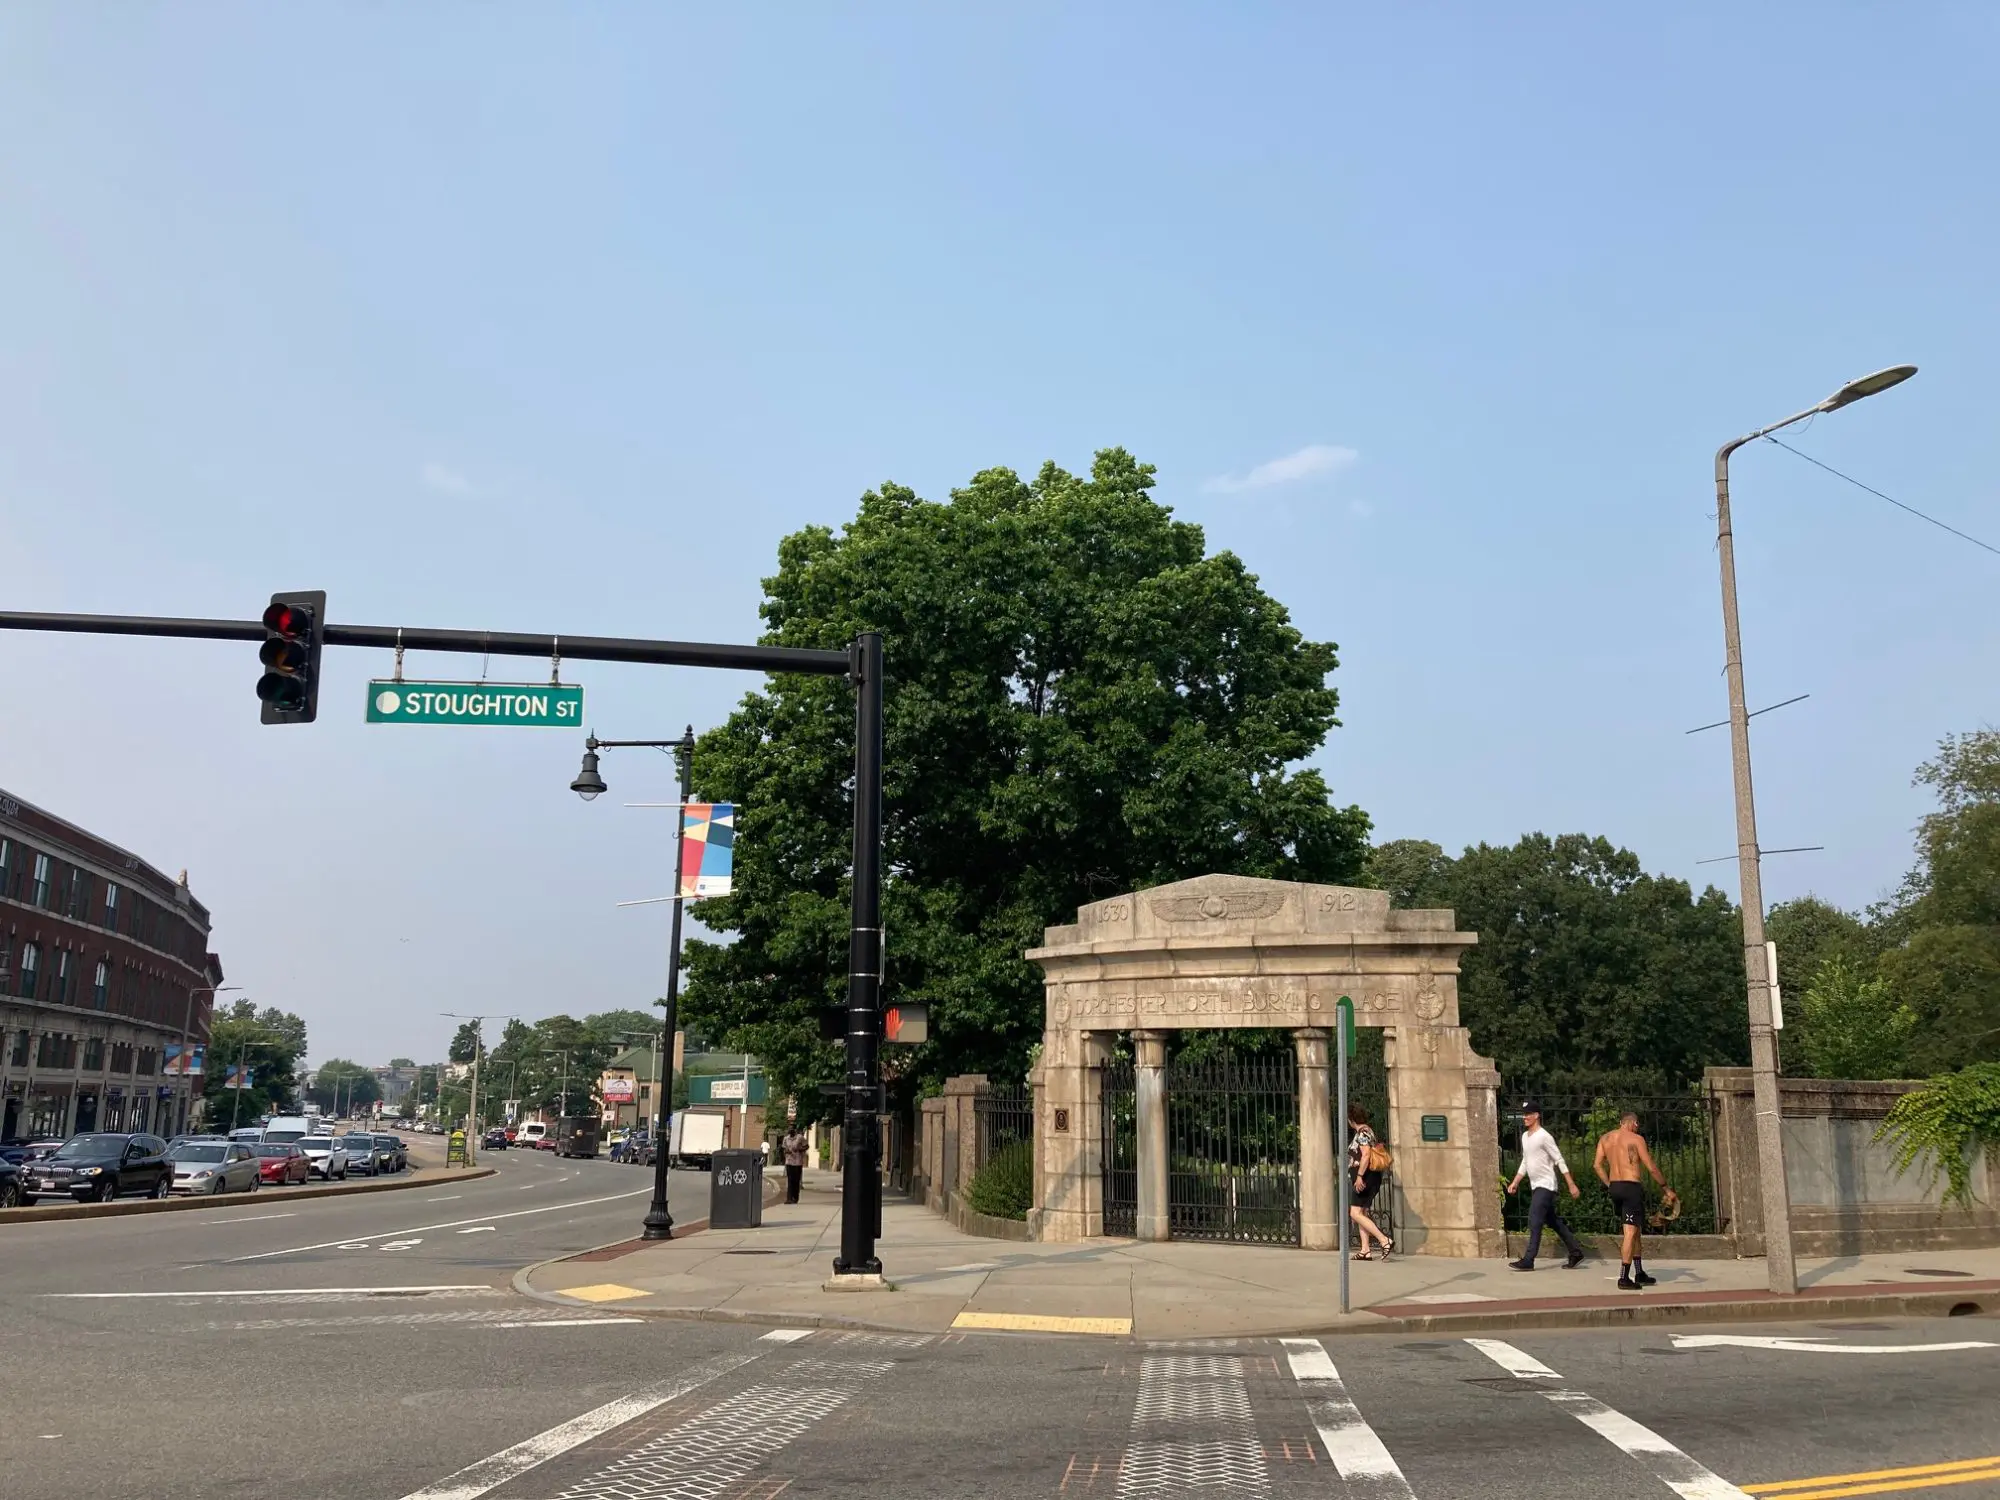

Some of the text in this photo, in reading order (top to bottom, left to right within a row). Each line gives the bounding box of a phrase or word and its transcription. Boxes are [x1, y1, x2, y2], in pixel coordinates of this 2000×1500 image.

[405, 691, 578, 718] STOUGHTON ST
[1099, 904, 1128, 922] 1630
[1319, 893, 1355, 912] 1912
[1075, 994, 1166, 1015] DORCHESTER
[1335, 992, 1401, 1011] ACE
